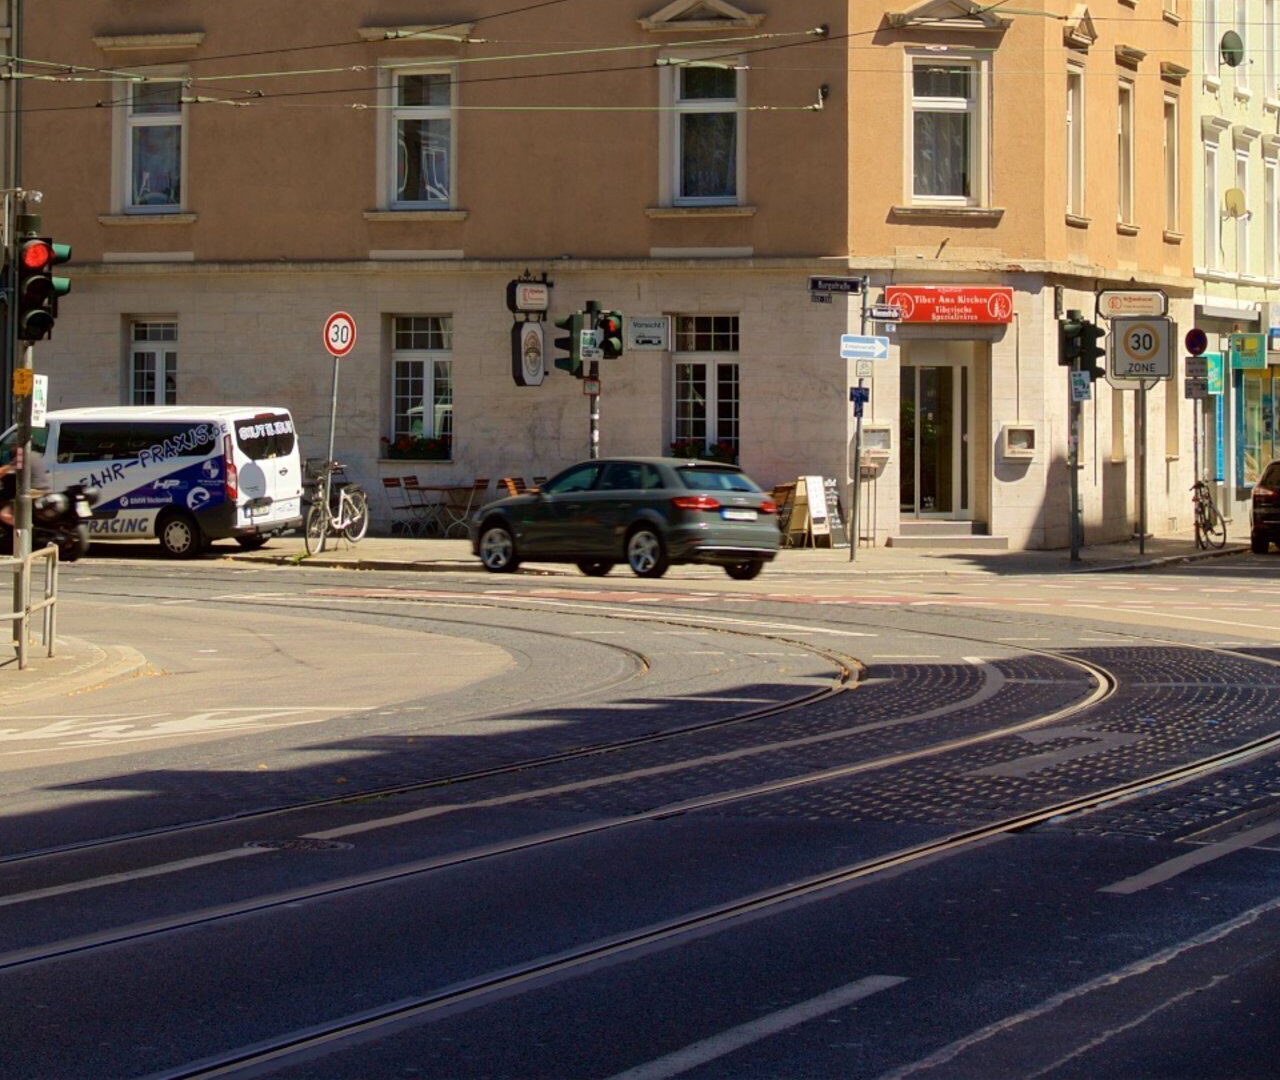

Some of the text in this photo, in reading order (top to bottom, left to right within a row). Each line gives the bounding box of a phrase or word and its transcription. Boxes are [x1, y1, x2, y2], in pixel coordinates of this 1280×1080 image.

[331, 324, 349, 344] 30
[1130, 332, 1153, 351] 30
[1128, 363, 1156, 373] ZONE
[88, 518, 149, 533] RACING
